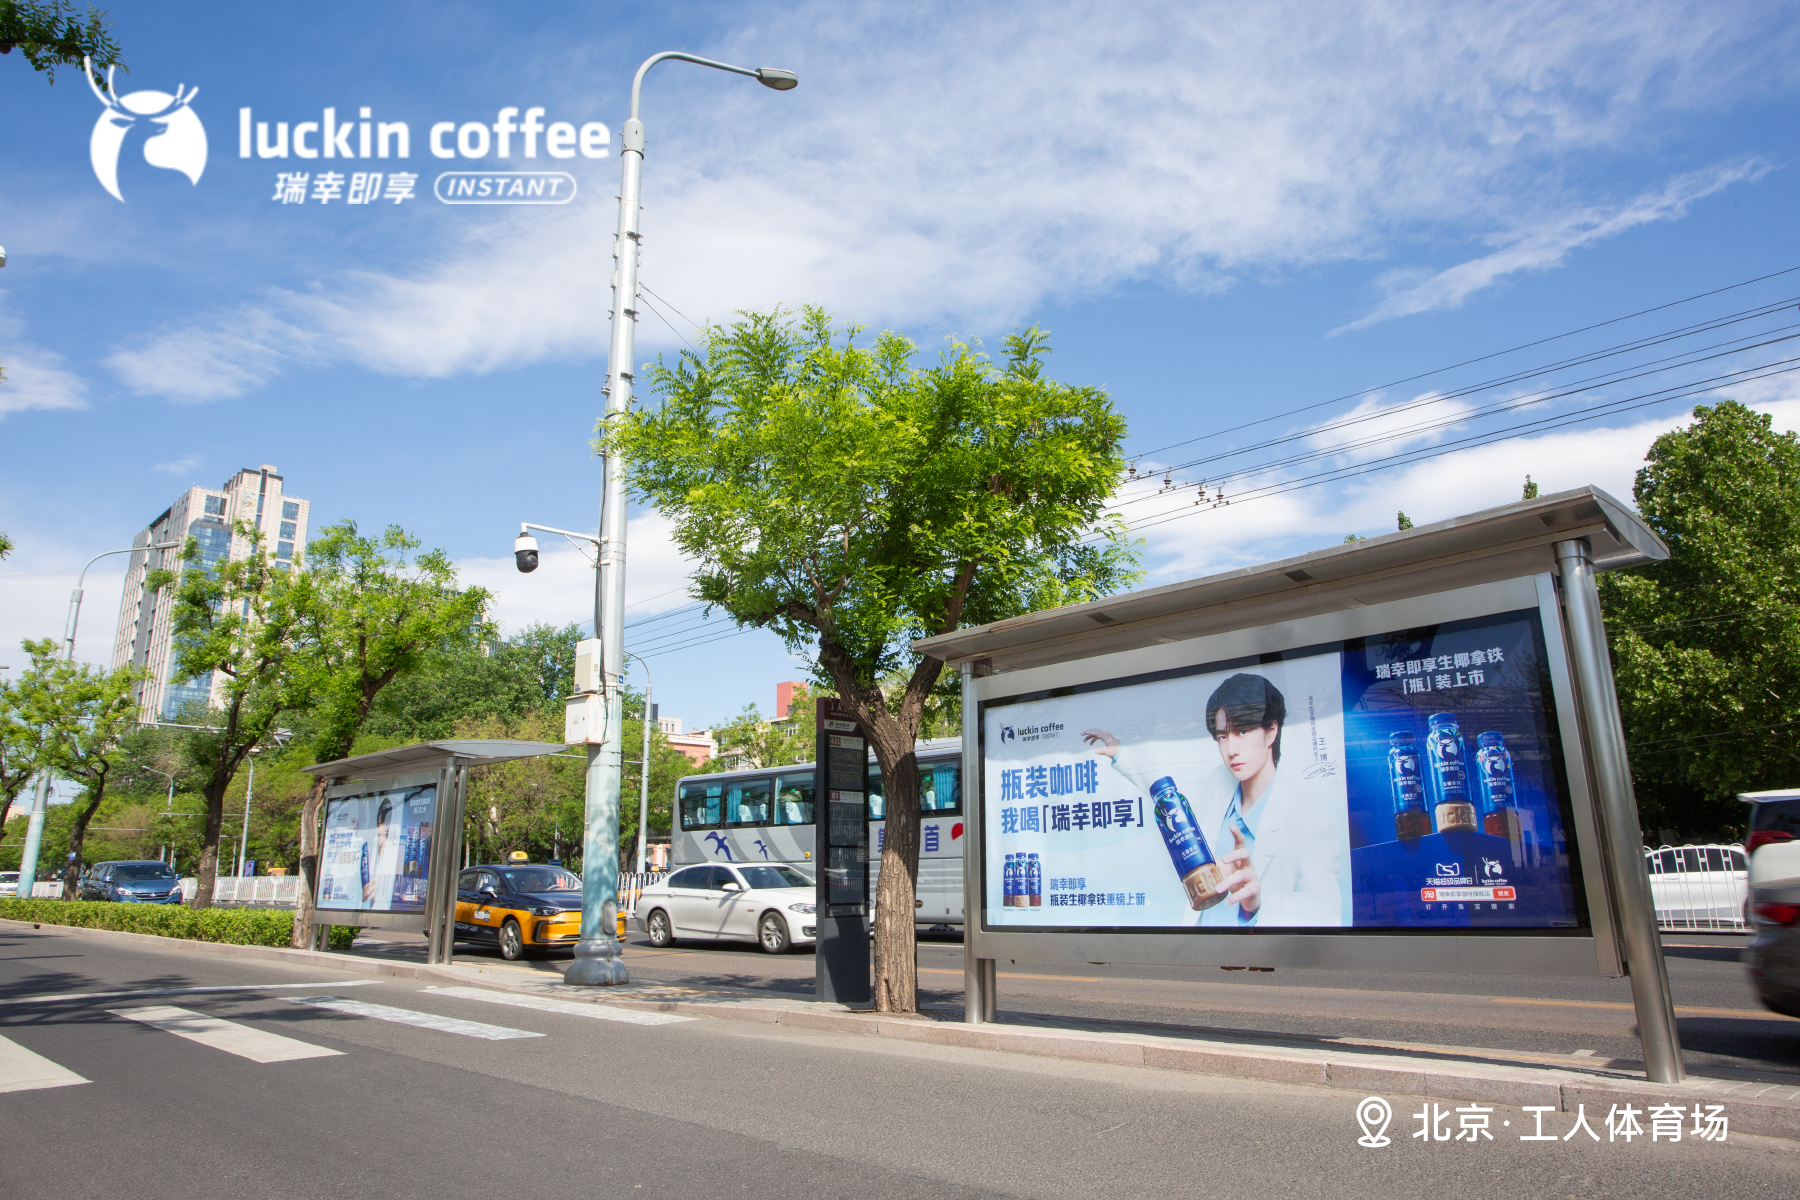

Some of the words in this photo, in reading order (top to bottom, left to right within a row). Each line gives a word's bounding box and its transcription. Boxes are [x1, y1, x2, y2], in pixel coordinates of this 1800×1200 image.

[1375, 647, 1505, 680] 瑞幸即享生椰拿铁
[1402, 669, 1485, 695] 「瓶」装上市
[1017, 725, 1039, 736] luckin
[1040, 722, 1064, 732] coffee
[1000, 760, 1099, 801] 瓶装咖啡
[1001, 797, 1144, 834] 我喝「瑞幸即享」
[1049, 877, 1087, 891] 瑞幸即享
[1049, 892, 1146, 907] 瓶装生椰拿铁重磅上新
